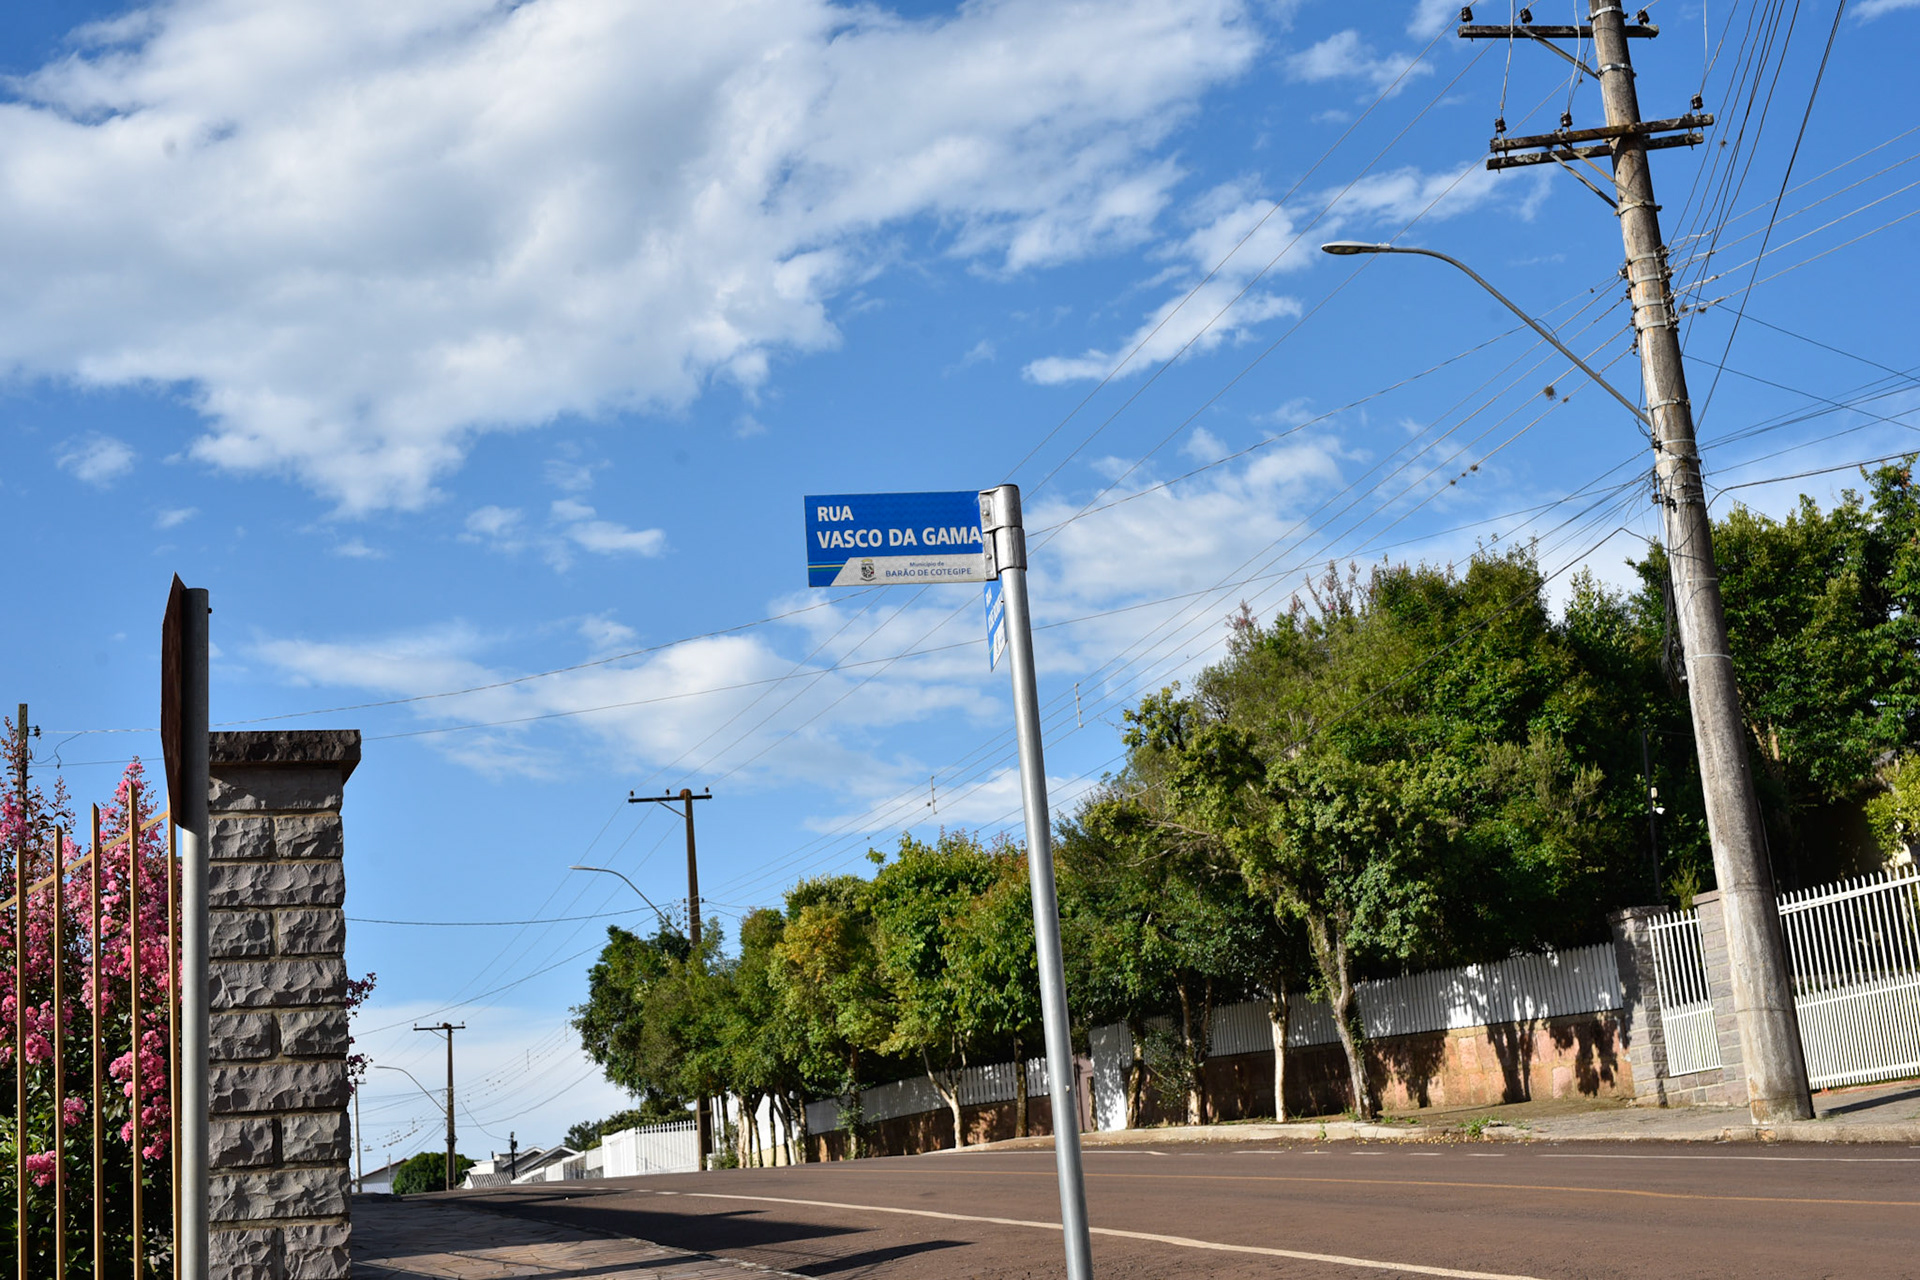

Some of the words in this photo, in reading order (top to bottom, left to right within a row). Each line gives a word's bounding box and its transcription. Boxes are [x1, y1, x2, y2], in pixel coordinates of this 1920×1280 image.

[817, 505, 854, 522] RUA
[816, 529, 883, 549] VASCO
[888, 528, 918, 547] DA
[922, 526, 983, 546] GAMA
[885, 568, 916, 578] BARÃO
[917, 569, 929, 577] DE
[930, 567, 972, 577] COTEGIPE
